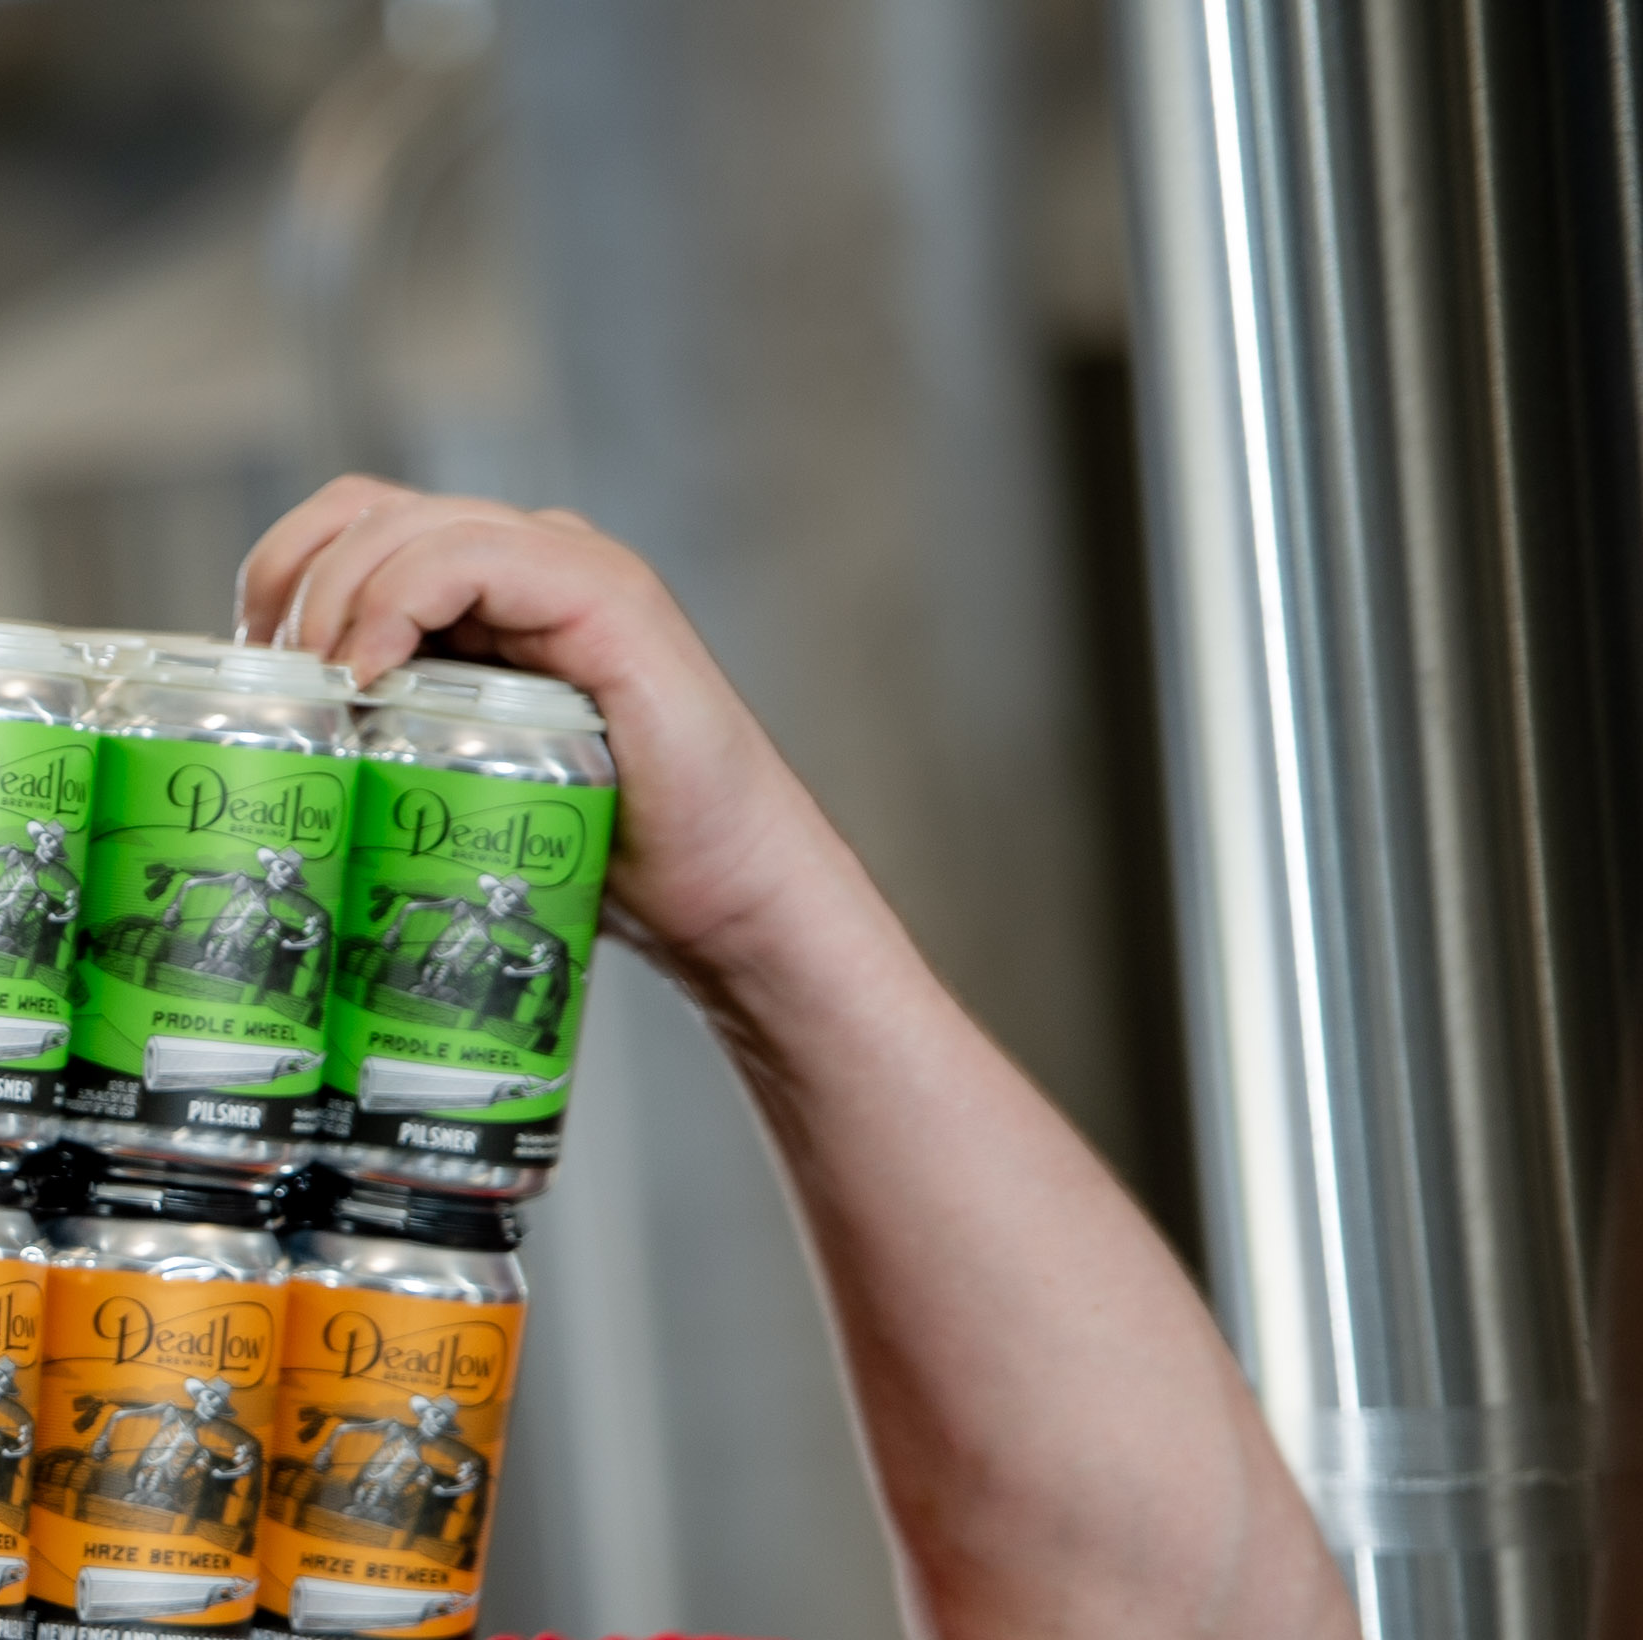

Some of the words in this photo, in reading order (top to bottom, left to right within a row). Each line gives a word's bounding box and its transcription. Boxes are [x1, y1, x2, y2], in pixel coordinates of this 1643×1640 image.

[167, 764, 288, 833] Dead
[291, 783, 336, 842] Low
[229, 823, 286, 838] BREWING
[393, 787, 511, 857] Dead
[517, 808, 572, 870] Low
[450, 848, 511, 866] BREWING
[18, 994, 60, 1016] WHEEL
[152, 1009, 234, 1036] PADDLE
[245, 1019, 298, 1042] WHEEL
[368, 1031, 448, 1059] PADDLE
[459, 1043, 522, 1068] WHEEL
[188, 1101, 262, 1128] PILSNER
[398, 1123, 478, 1153] PILSNER
[93, 1296, 213, 1366] Dead
[217, 1314, 263, 1372] Low
[156, 1355, 214, 1371] BREWING
[323, 1311, 441, 1380] Dead
[447, 1334, 498, 1390] Low
[83, 1542, 140, 1565] HAZE
[150, 1548, 232, 1571] BETWEEN
[301, 1551, 356, 1573] HAZE
[365, 1560, 449, 1584] BETWEEN
